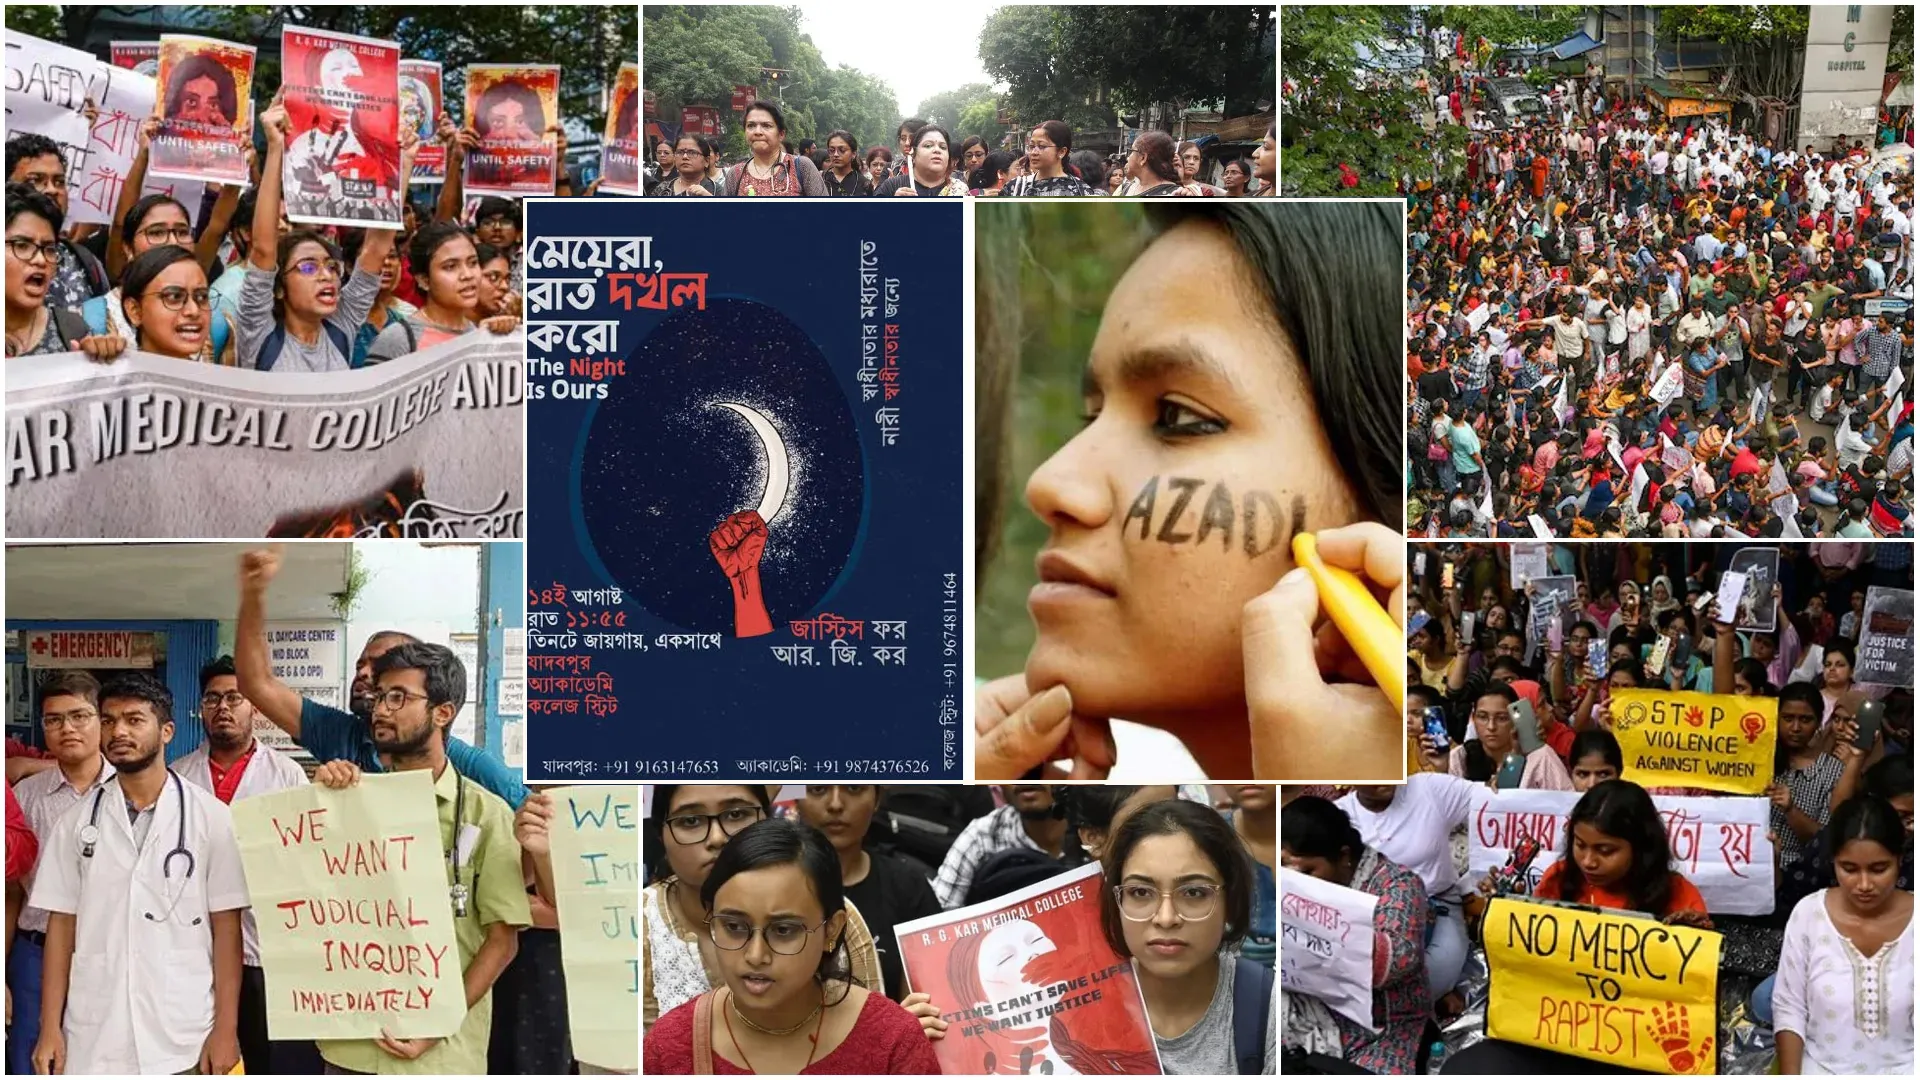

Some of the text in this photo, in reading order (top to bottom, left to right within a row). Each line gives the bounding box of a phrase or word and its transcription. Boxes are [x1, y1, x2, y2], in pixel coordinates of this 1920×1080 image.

[1844, 32, 1856, 52] C
[1828, 60, 1866, 72] HOSPITAL
[158, 136, 240, 155] UNTIL SAFETY
[471, 154, 552, 165] UNTIL SAFETY
[528, 236, 664, 278] মেয়েরা,
[528, 272, 709, 314] রাত দখল
[528, 320, 620, 355] করো
[528, 357, 626, 381] The Night
[528, 378, 609, 400] Is Ours
[89, 392, 292, 464] MEDICAL
[307, 369, 450, 451] COLLEGE
[451, 358, 523, 410] AND
[875, 405, 901, 447] নারী
[1121, 474, 1308, 561] AZADI
[528, 611, 560, 629] রাত
[943, 572, 957, 657] 9674811464
[275, 630, 307, 642] DAYCARE
[308, 629, 336, 642] CENTRE
[528, 629, 578, 650] তিনটে
[654, 632, 722, 650] একসাথে
[871, 620, 908, 641] ফর
[1867, 636, 1908, 650] JUSTICE
[50, 631, 133, 658] EMERGENCY
[286, 648, 310, 660] BLOCK
[770, 639, 908, 666] আর. জি. কর
[1865, 647, 1886, 659] FOR
[528, 655, 592, 675] যাদবপুর
[943, 663, 957, 689] +91
[1864, 659, 1898, 673] VICTIM
[528, 699, 580, 715] কলেজ
[1644, 730, 1740, 755] VIOLENCE
[603, 761, 629, 774] +91
[635, 760, 720, 775] 9163147653
[813, 760, 839, 774] +91
[845, 759, 930, 774] 9874376526
[1635, 755, 1756, 778] AGAINST WOMEN
[568, 794, 637, 831] WE
[272, 808, 328, 847] WE
[322, 836, 415, 877] WANT
[580, 852, 638, 886] IM
[276, 896, 430, 930] JUDICIAL
[921, 885, 1084, 947] R. G. KAR MEDICAL COLLEGE
[322, 940, 449, 980] INQURY
[1507, 911, 1703, 985] NO MERCY
[292, 985, 433, 1014] IMMEDIATELY
[942, 1004, 994, 1024] CTIMS
[997, 988, 1043, 1013] CAN'T
[1047, 975, 1089, 998] SAVE
[1576, 972, 1622, 1002] TO
[960, 989, 1103, 1038] WE WANT JUSTICE
[1533, 996, 1646, 1059] RAPIST
